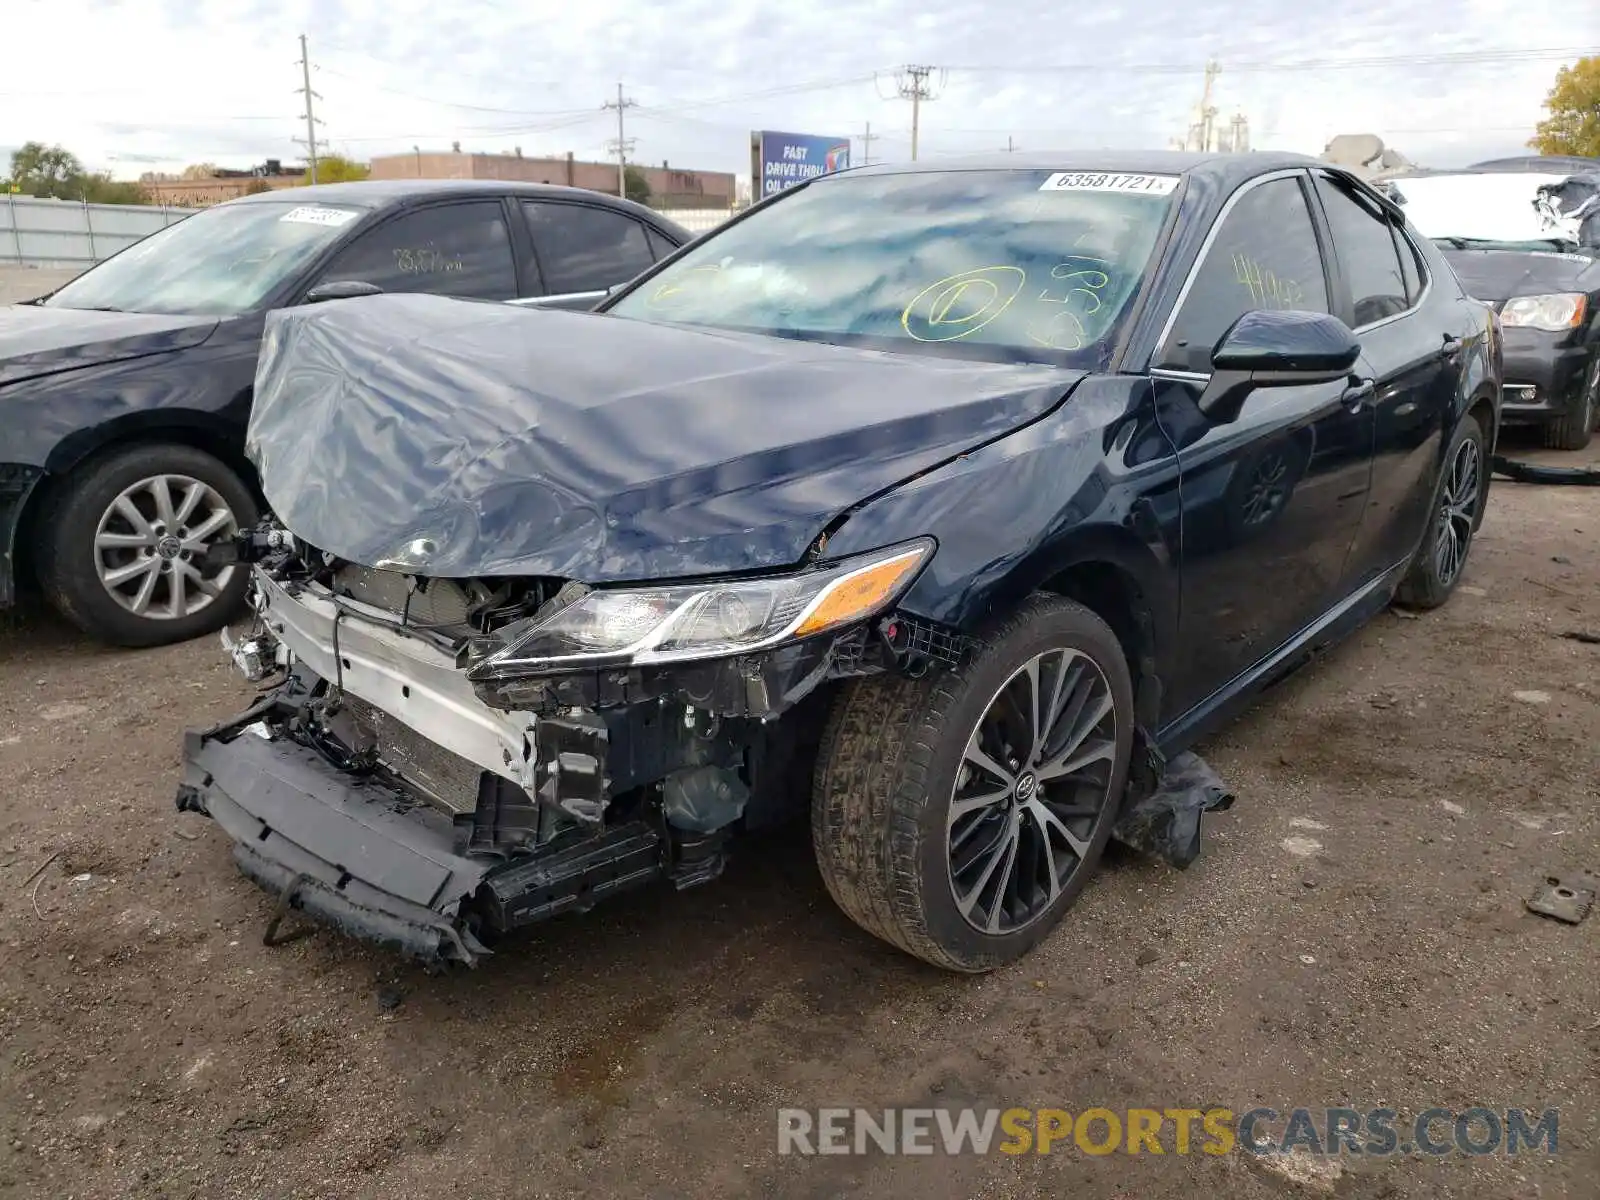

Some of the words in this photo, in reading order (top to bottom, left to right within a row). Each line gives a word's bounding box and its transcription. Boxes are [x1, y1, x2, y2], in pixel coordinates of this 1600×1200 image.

[783, 145, 808, 160] FAST
[765, 161, 796, 176] DRIVE
[798, 163, 824, 177] THRU
[765, 178, 781, 193] OIL
[1056, 174, 1158, 190] 63581721
